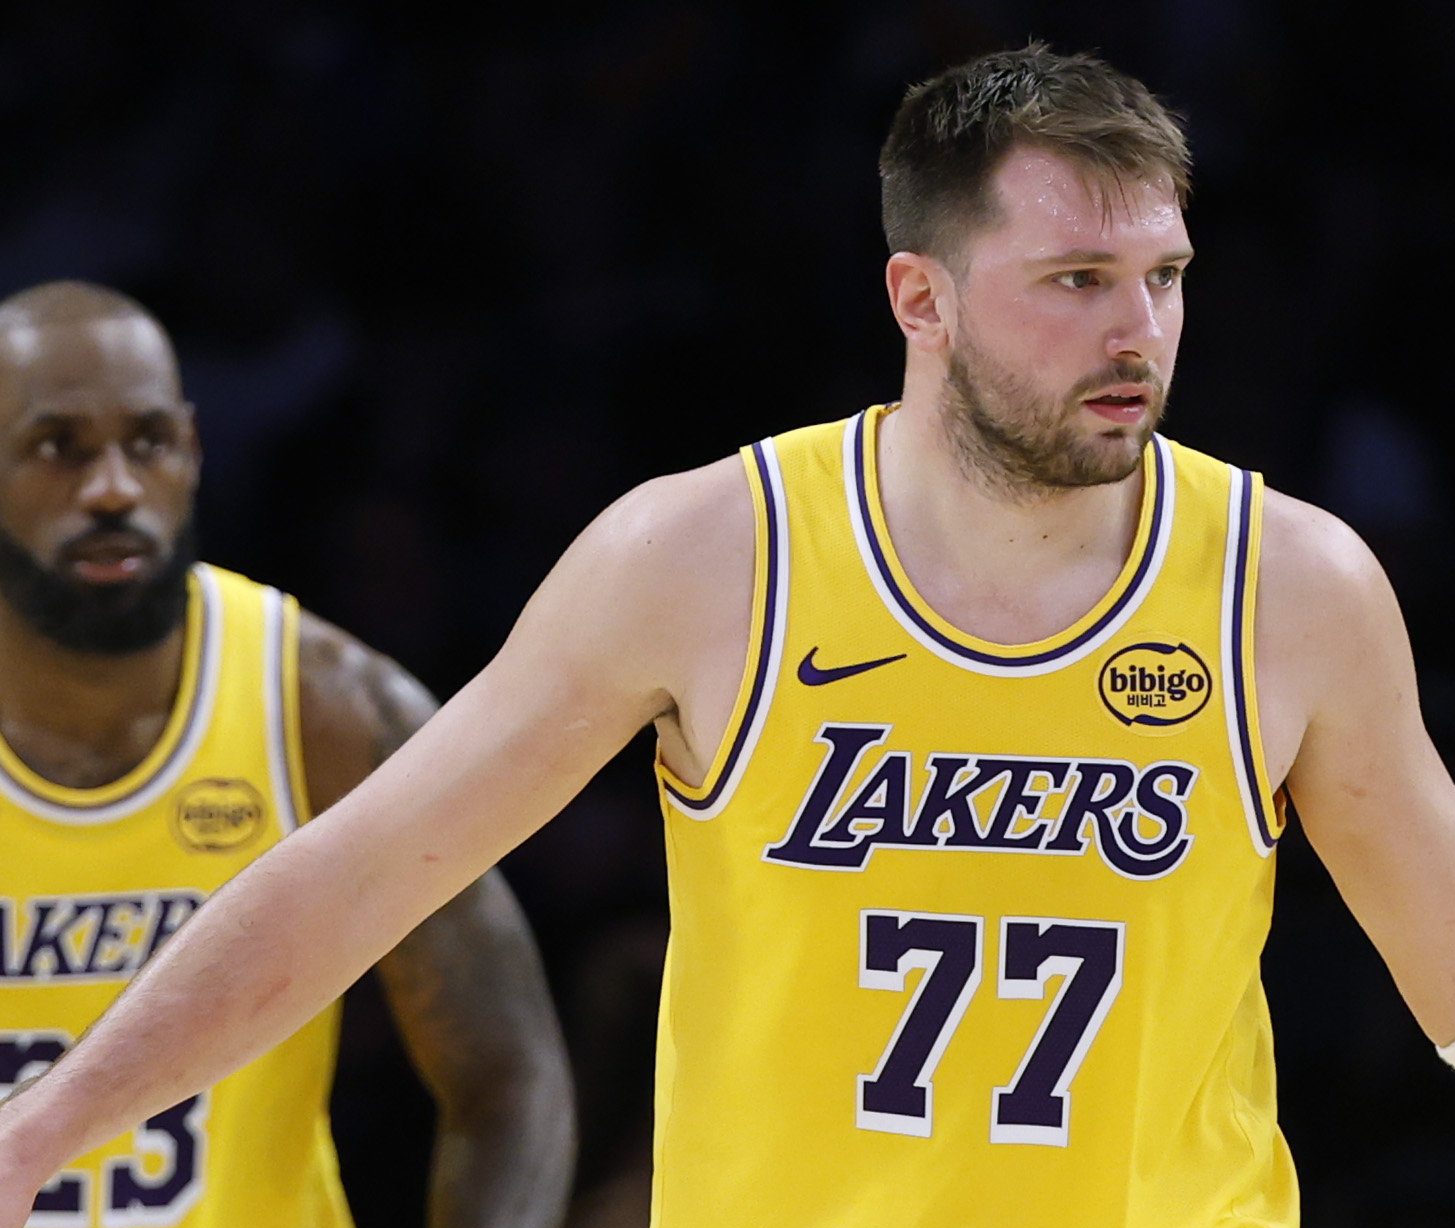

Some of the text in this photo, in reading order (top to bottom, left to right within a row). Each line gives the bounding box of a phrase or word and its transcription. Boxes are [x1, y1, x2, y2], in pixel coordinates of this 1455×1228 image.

[1110, 665, 1204, 702] bibigo
[1127, 694, 1167, 708] 비비고
[761, 722, 1200, 881] LAKERS
[856, 908, 1126, 1148] 77
